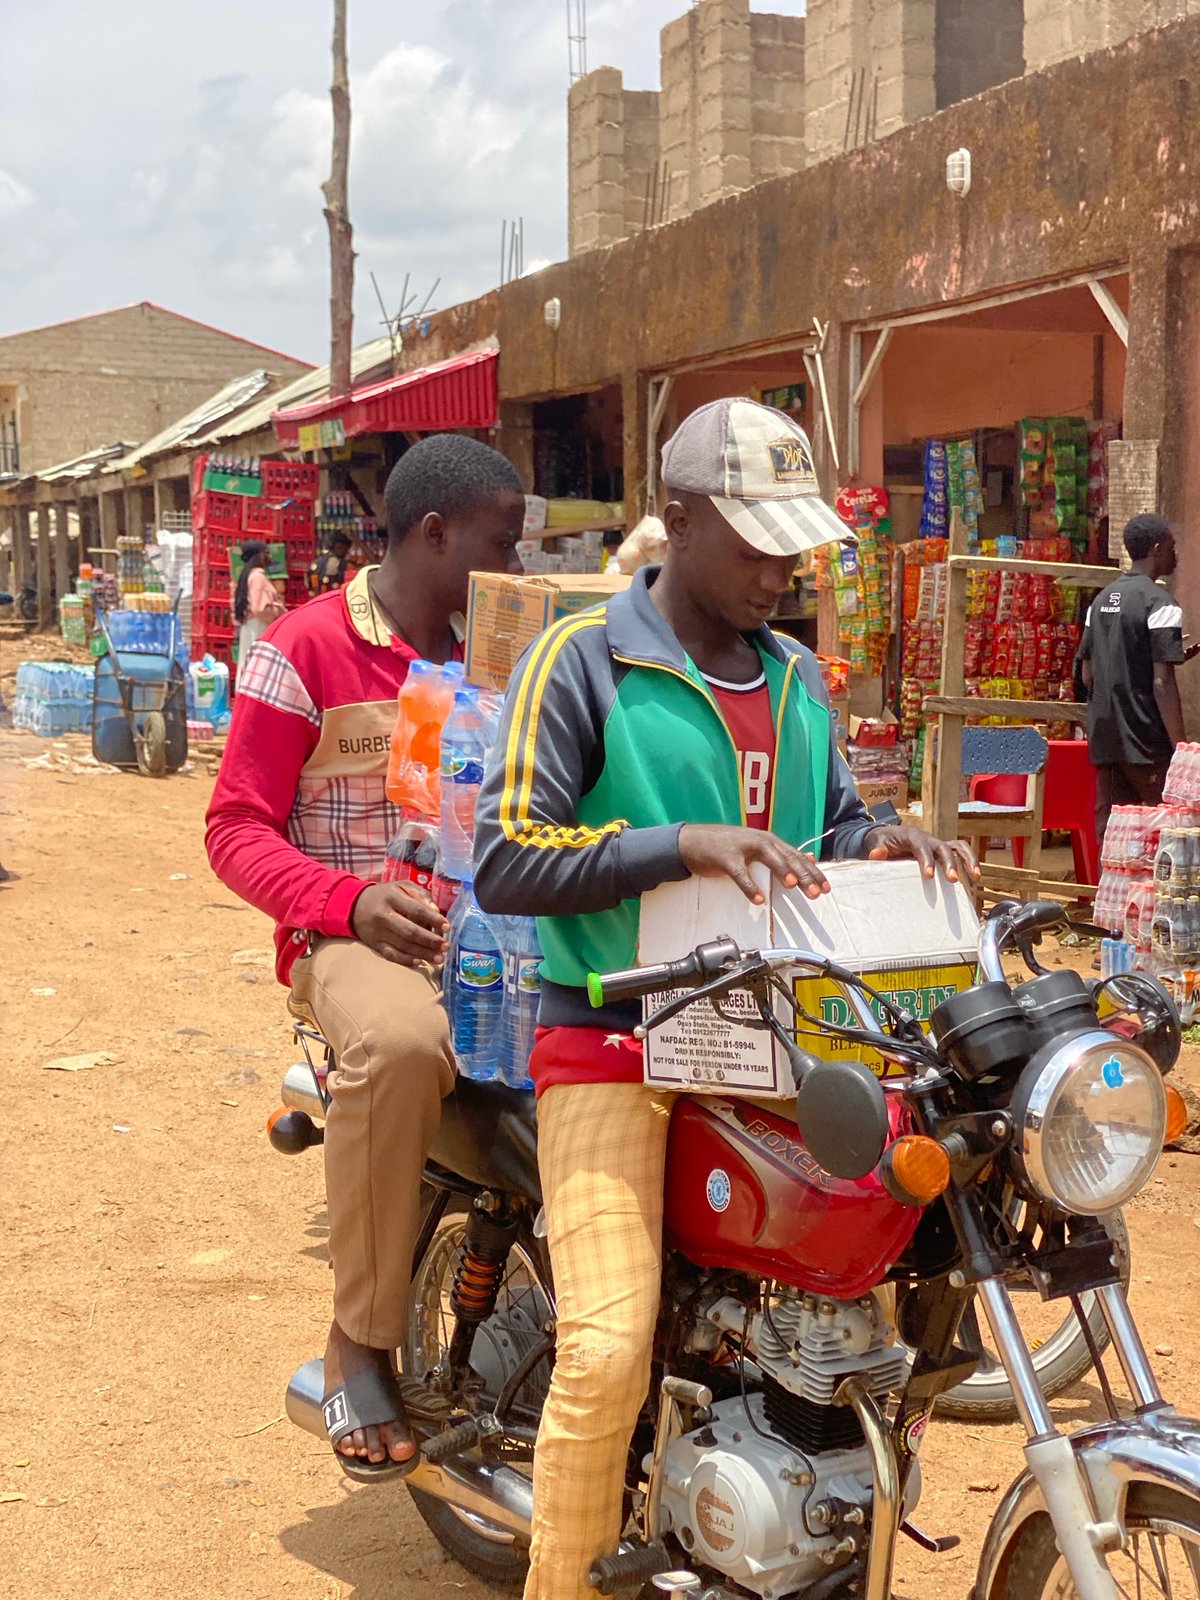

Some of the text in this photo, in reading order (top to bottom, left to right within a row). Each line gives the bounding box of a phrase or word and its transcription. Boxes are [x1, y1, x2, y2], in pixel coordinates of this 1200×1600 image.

[844, 494, 878, 507] Cerelac
[338, 735, 391, 753] BURBE
[736, 750, 769, 814] B
[463, 956, 497, 968] Swan
[747, 994, 758, 1009] LT
[660, 1035, 687, 1046] NAFDAC
[688, 1037, 706, 1047] REG.
[723, 1039, 757, 1051] B1-5994L
[695, 1048, 742, 1059] RESPONSIBLY:
[653, 1056, 665, 1064] NOT
[664, 1057, 676, 1065] FOR
[675, 1058, 689, 1066] SALE
[689, 1059, 701, 1068] FOR
[701, 1060, 724, 1069] PERSON
[723, 1061, 742, 1071] UNDER
[750, 1065, 769, 1073] YEARS
[743, 1119, 832, 1187] BOXER
